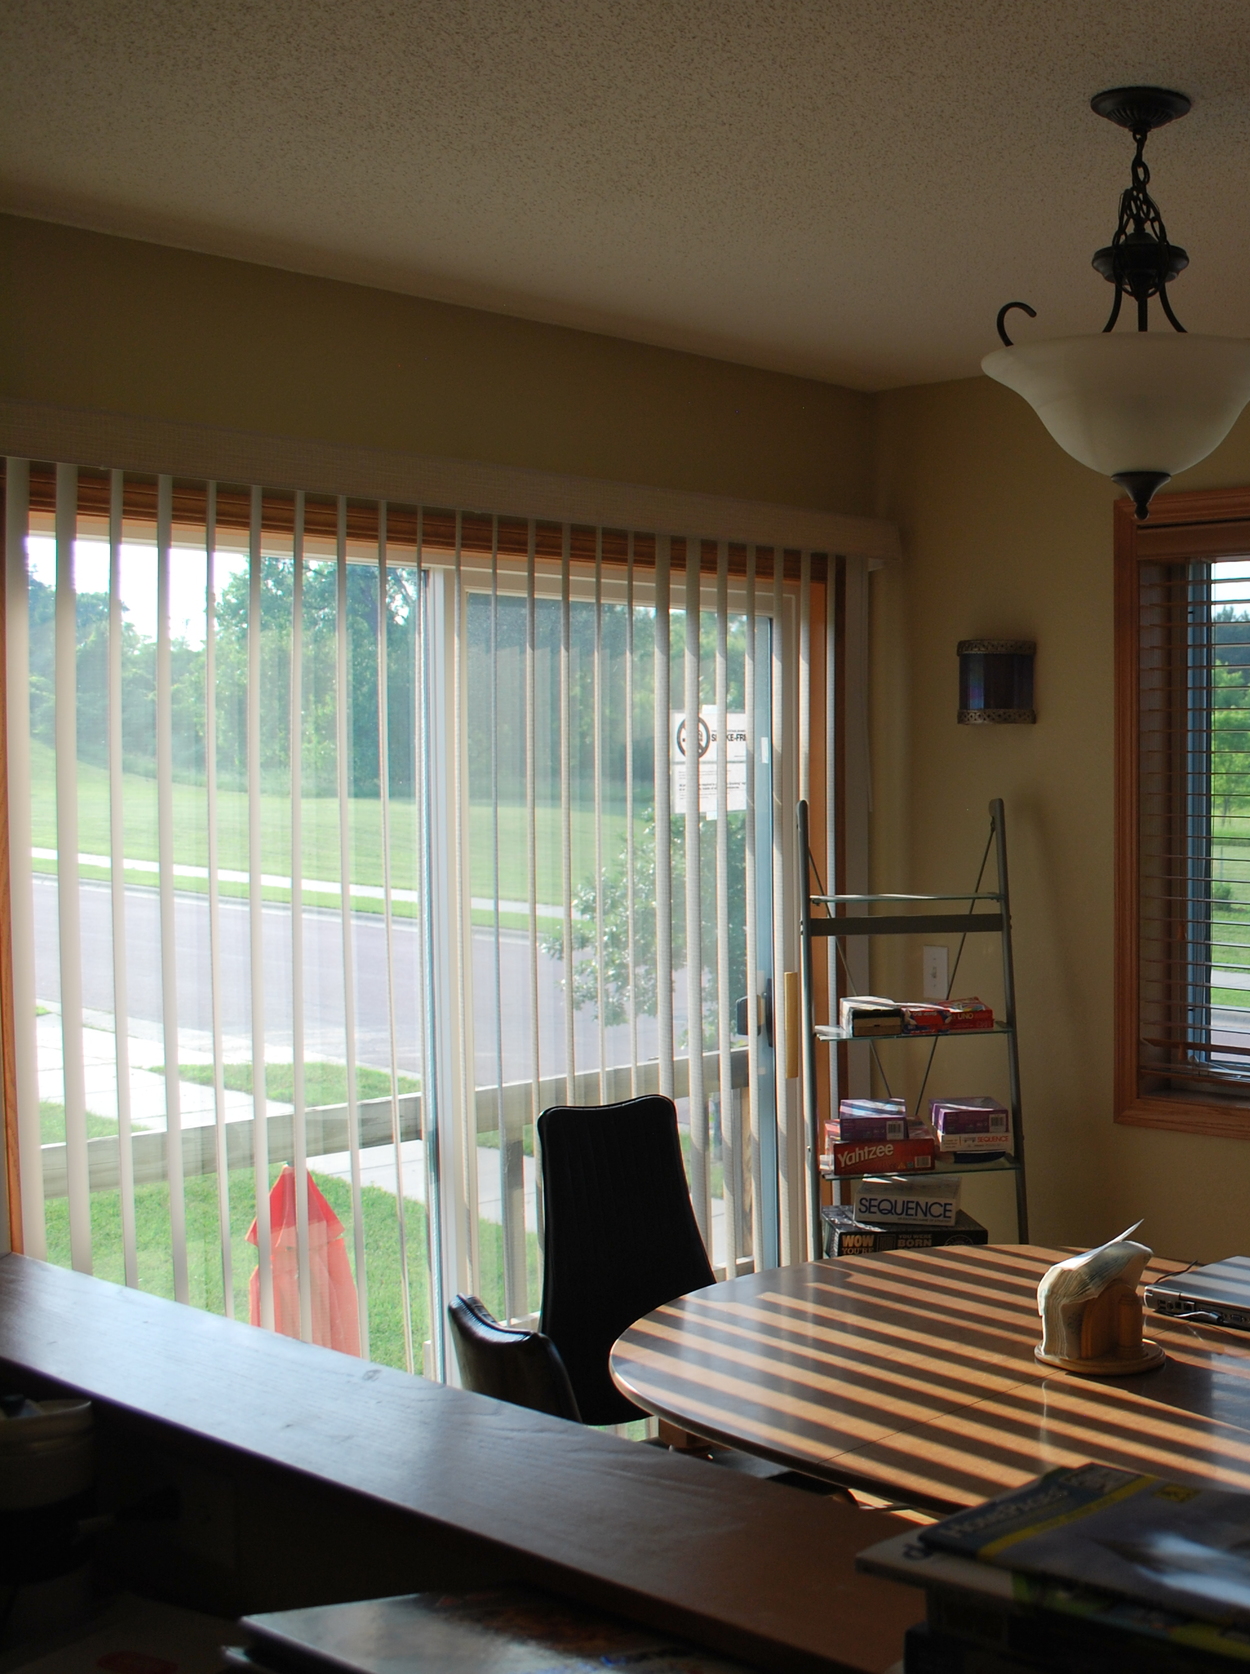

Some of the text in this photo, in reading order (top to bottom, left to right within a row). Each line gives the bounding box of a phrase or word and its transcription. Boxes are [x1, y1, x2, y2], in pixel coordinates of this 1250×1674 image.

[977, 1135, 1009, 1143] SEQUENCE
[837, 1144, 893, 1167] Yahtzee
[859, 1198, 953, 1218] SEQUENCE
[842, 1234, 874, 1247] WOW
[897, 1239, 932, 1248] BORN
[841, 1247, 874, 1255] YOU'RE
